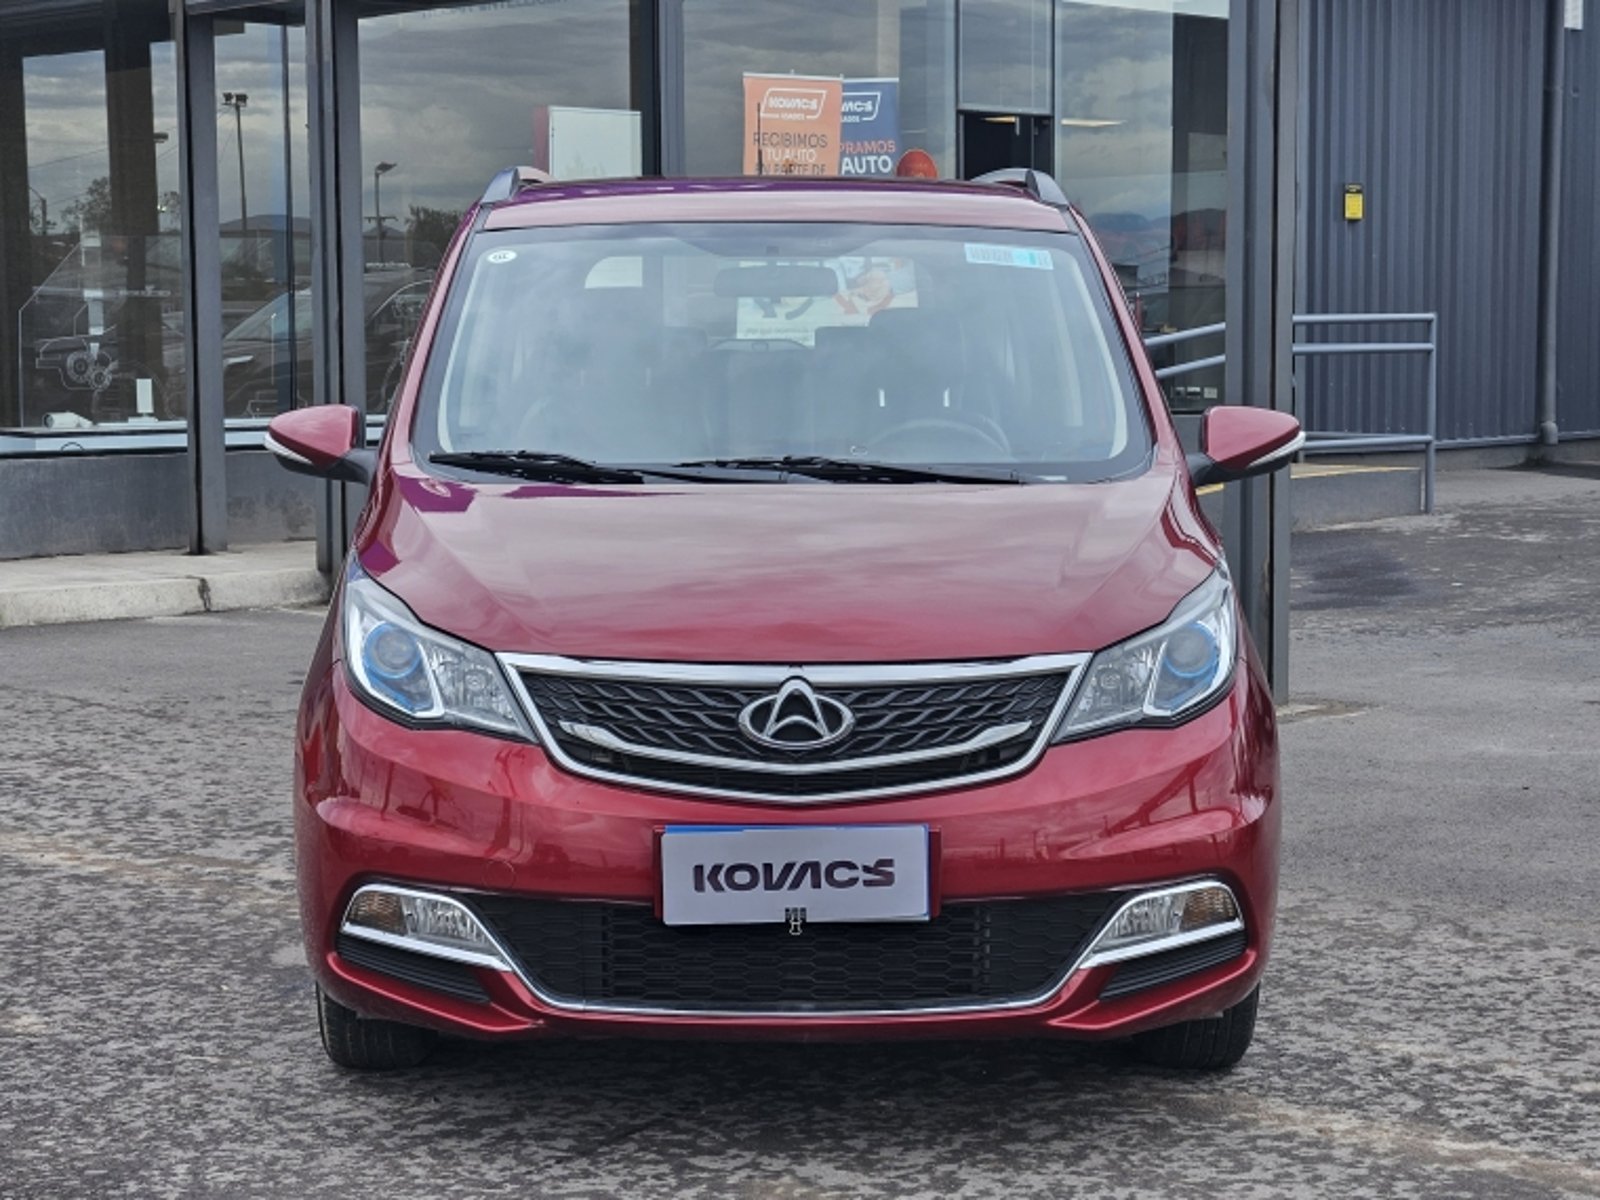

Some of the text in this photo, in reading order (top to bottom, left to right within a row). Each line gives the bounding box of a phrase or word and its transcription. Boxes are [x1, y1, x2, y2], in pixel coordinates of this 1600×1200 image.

[841, 100, 873, 113] VACS
[753, 132, 828, 148] RECIBIMOS
[840, 140, 896, 154] PRAMOS
[767, 148, 816, 162] TU AUTO
[841, 155, 893, 175] AUTO
[693, 858, 896, 893] KOVACS
